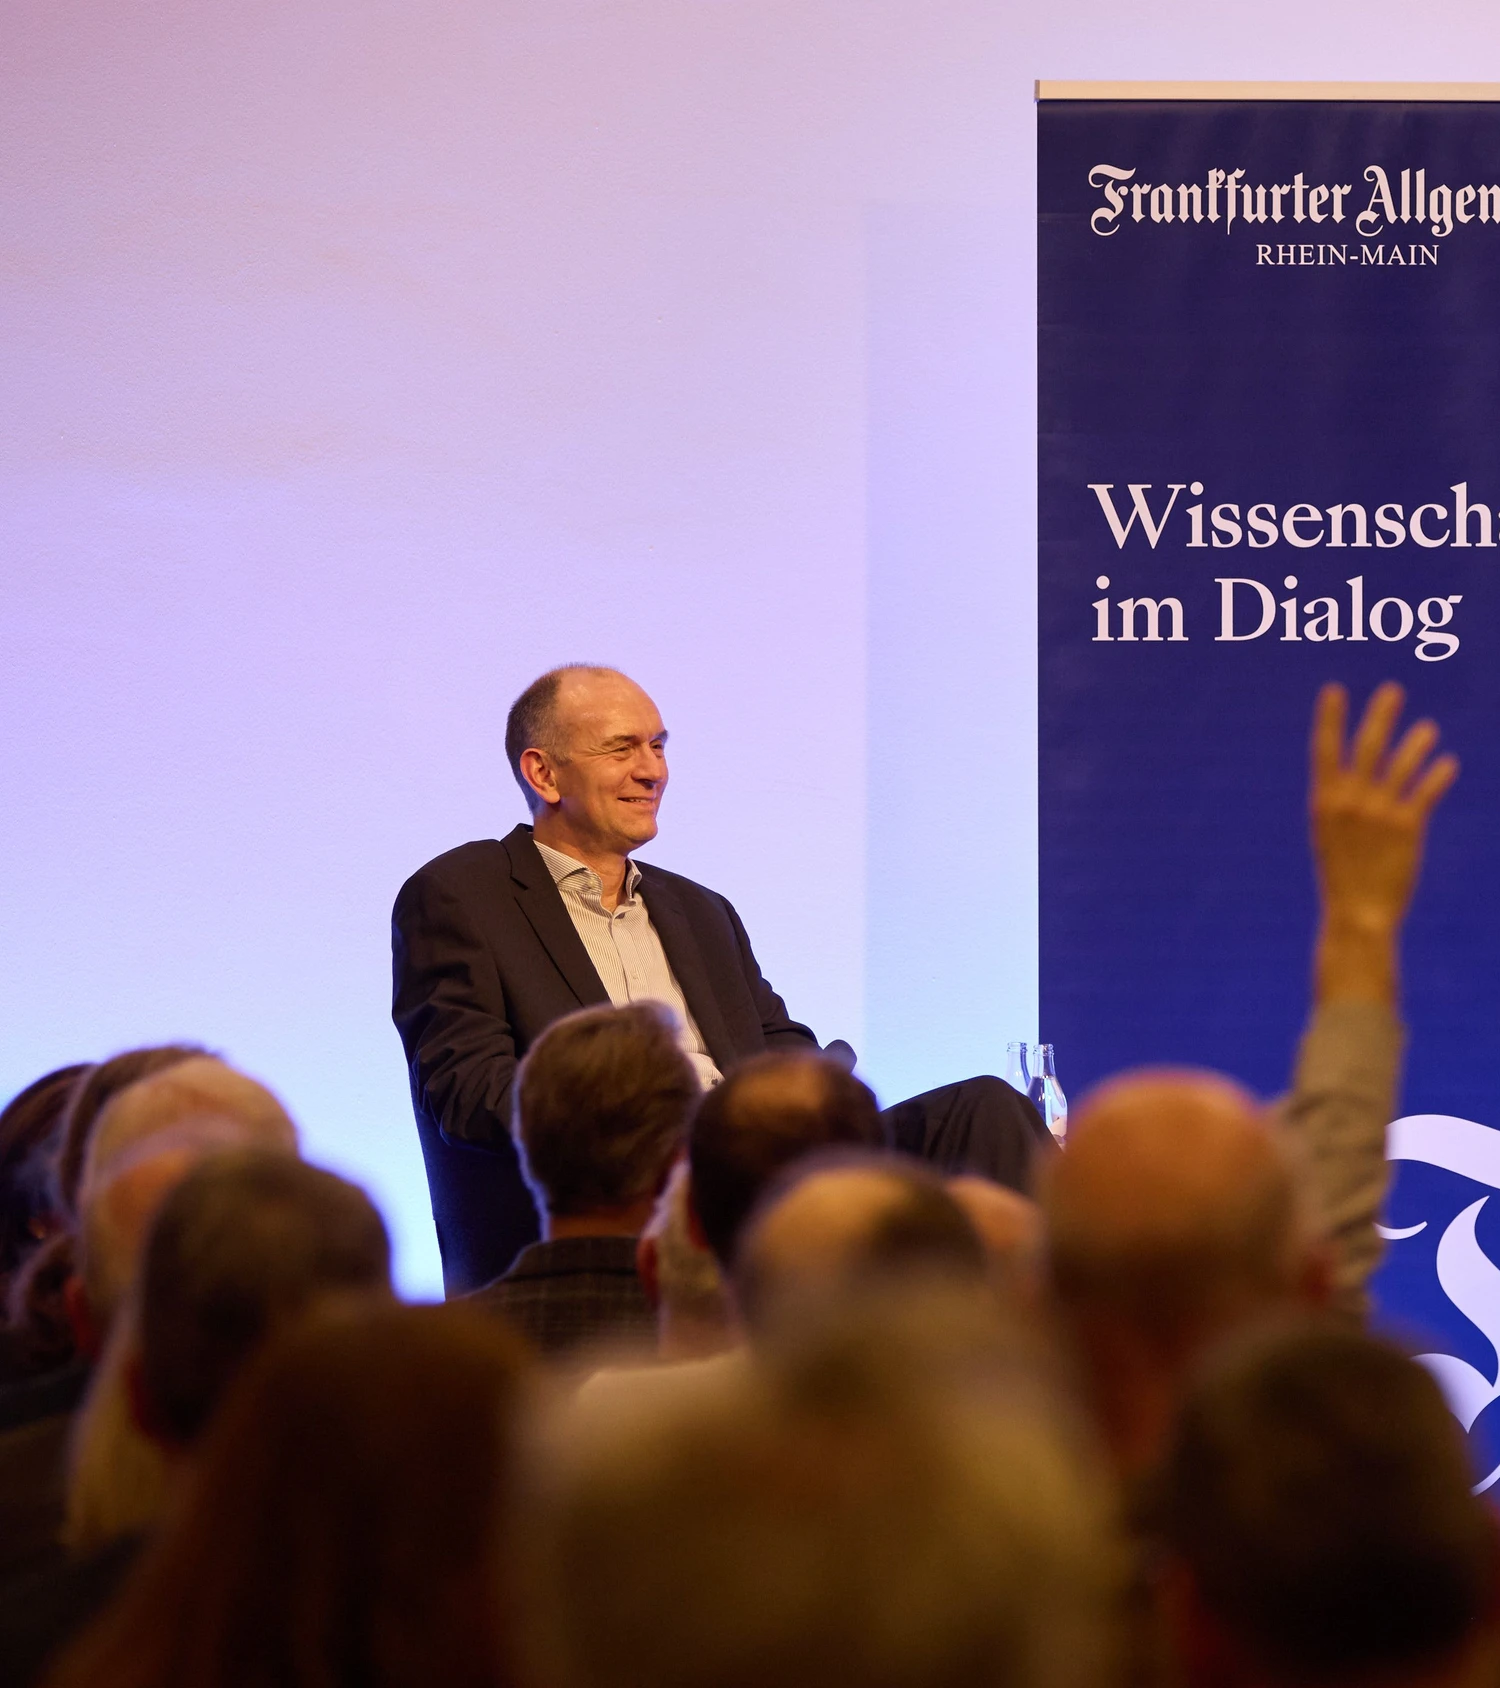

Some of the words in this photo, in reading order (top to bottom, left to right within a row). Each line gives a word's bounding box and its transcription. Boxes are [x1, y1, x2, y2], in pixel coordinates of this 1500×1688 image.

[1087, 163, 1353, 237] Frankfurter
[1255, 244, 1440, 266] RHEIN-MAIN
[1091, 575, 1190, 642] im
[1214, 574, 1464, 662] Dialog
